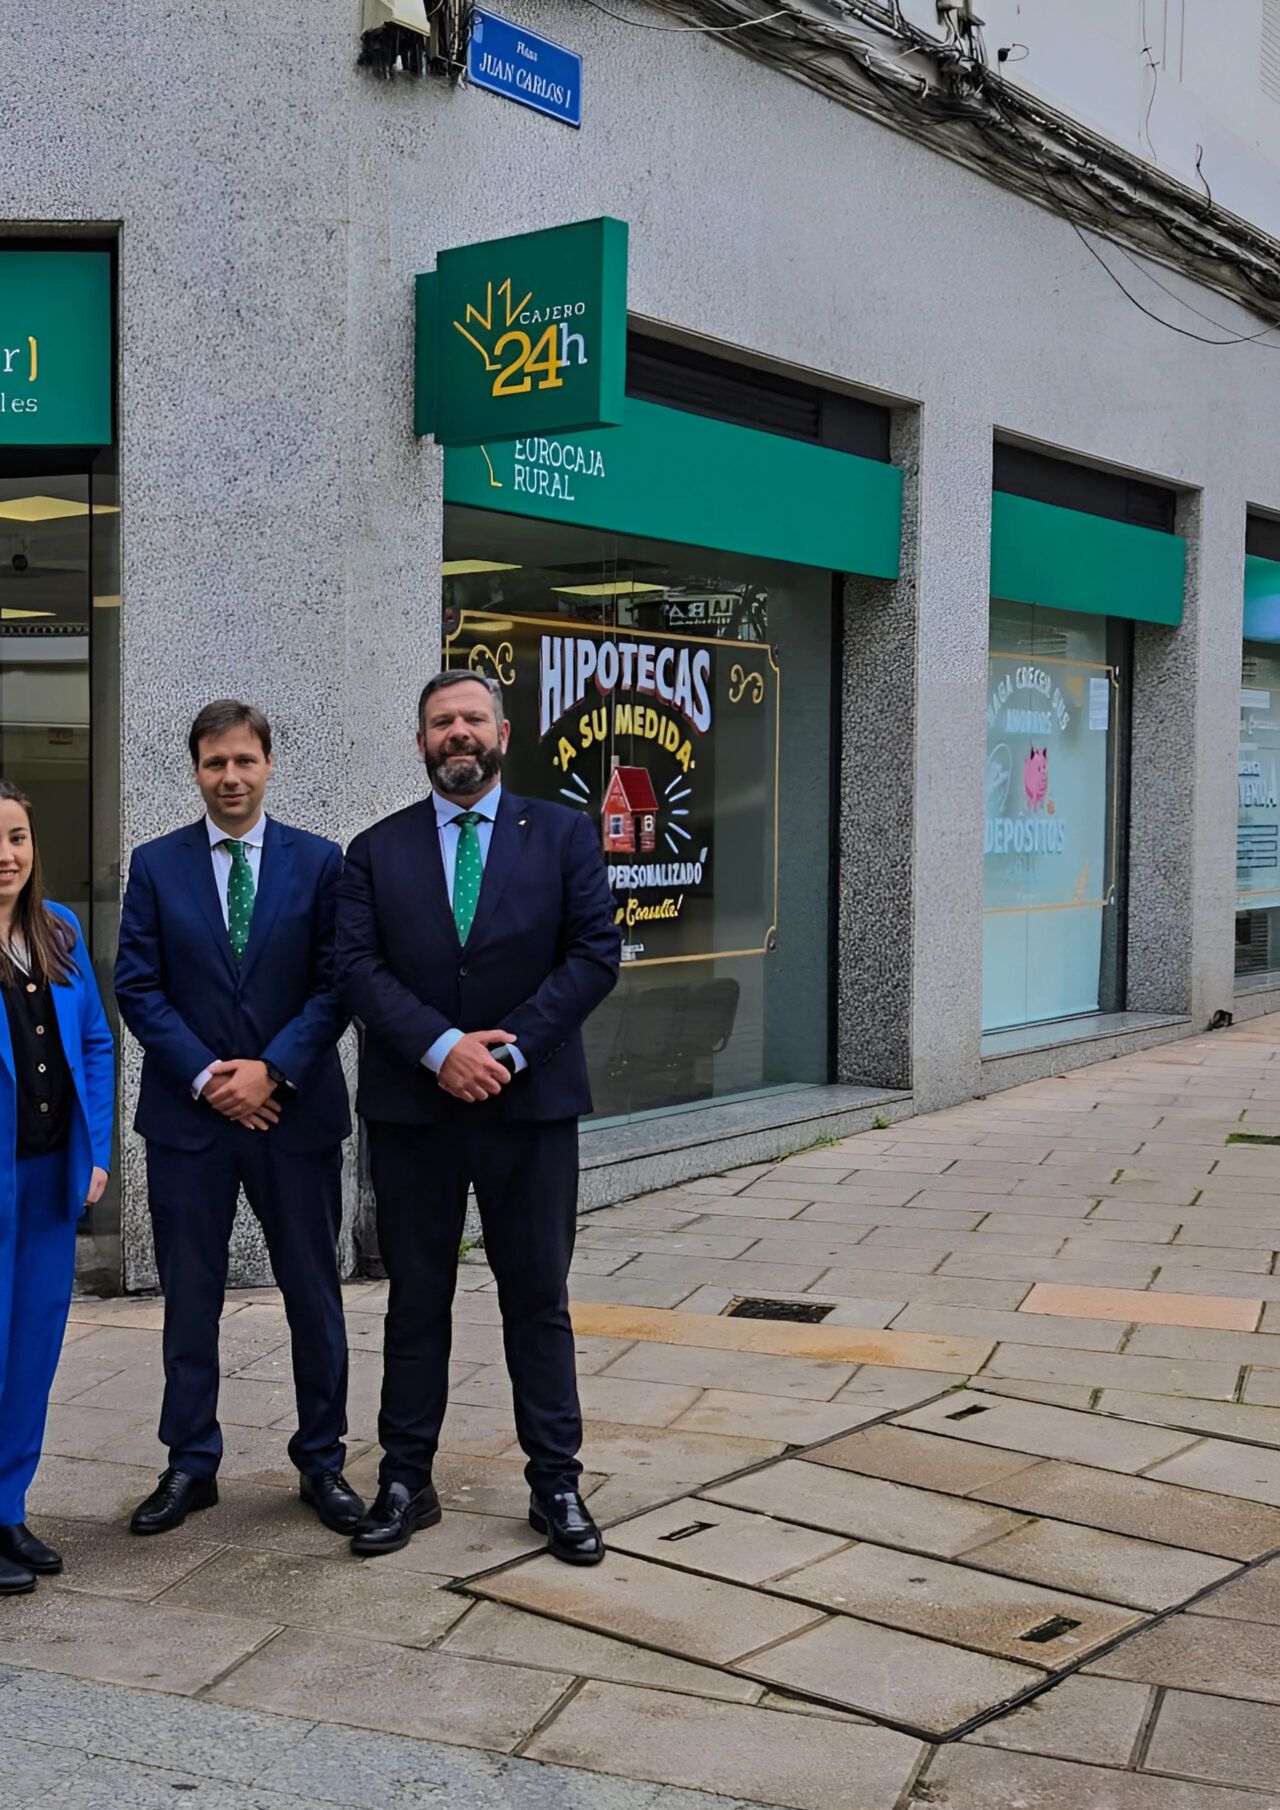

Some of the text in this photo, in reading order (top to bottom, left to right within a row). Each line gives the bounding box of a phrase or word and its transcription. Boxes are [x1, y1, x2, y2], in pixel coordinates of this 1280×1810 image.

[479, 53, 571, 109] JUAN CARLOS I
[520, 302, 586, 325] CAJERO
[492, 322, 588, 397] 24h
[514, 437, 606, 478] EUROCAJA
[514, 463, 575, 501] RURAL
[539, 634, 711, 738] HIPOTECAS
[579, 708, 608, 749] SU
[615, 703, 693, 773] MEDIDA
[608, 862, 702, 891] PERSONALIZADO
